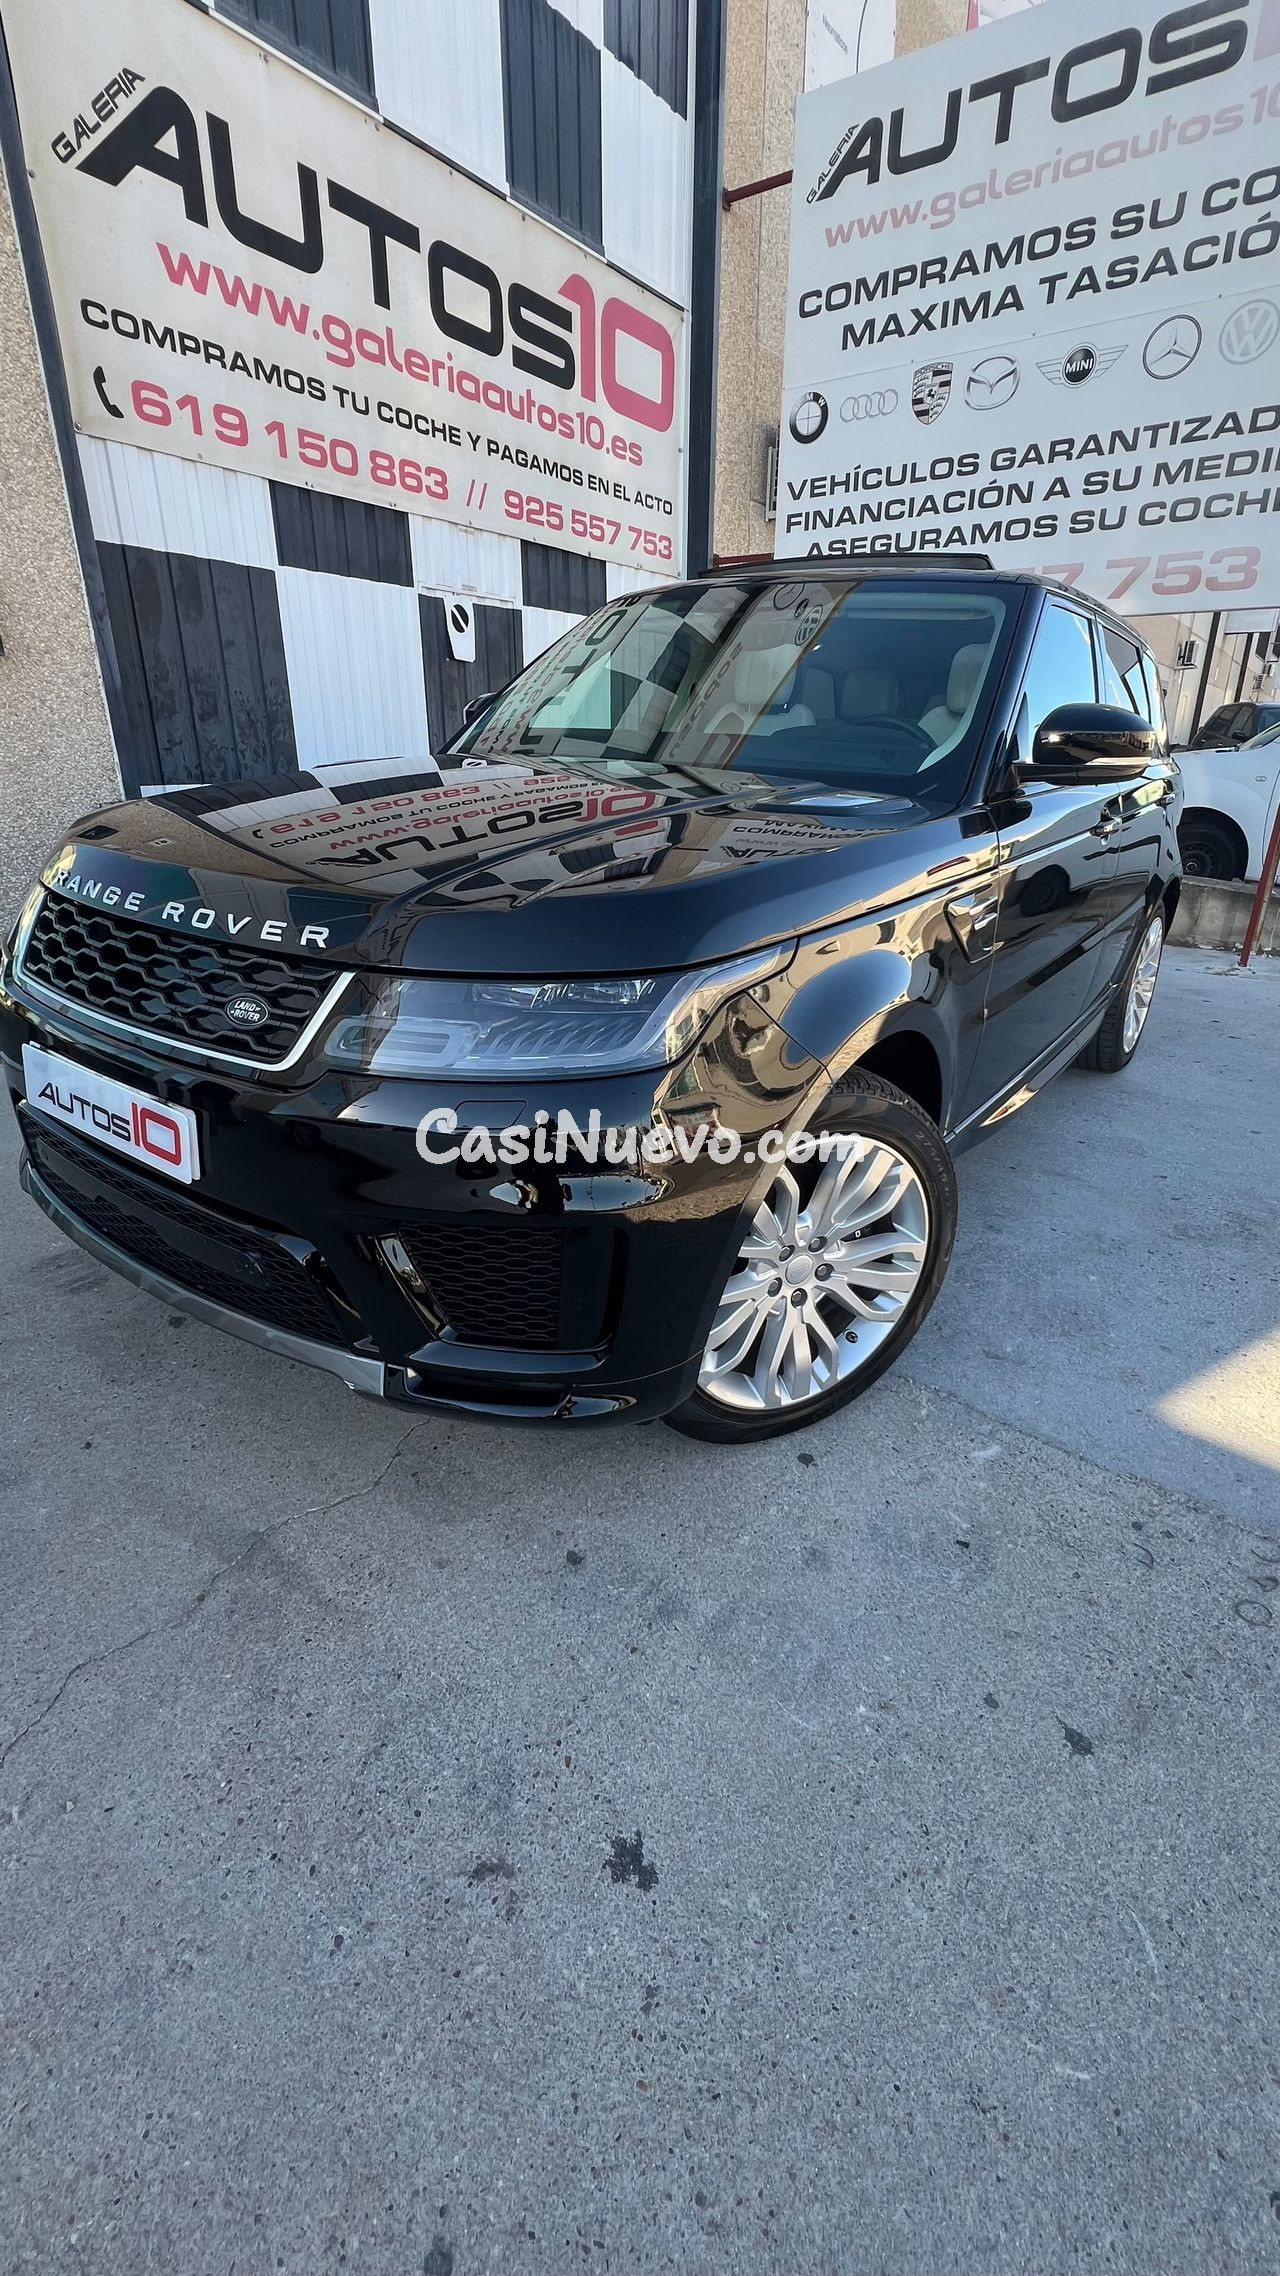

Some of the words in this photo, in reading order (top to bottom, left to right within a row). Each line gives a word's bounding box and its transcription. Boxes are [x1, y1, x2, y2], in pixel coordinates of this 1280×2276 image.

[51, 67, 146, 163] GALERIA
[75, 86, 674, 432] AUTOS10
[799, 217, 1096, 319] COMPRAMOS
[1110, 190, 1187, 240] SU
[1201, 166, 1280, 217] CO
[841, 285, 1026, 351] MAXIMA
[1039, 211, 1280, 305] TASACIÓ
[156, 242, 643, 467] www.galeriaautos10.es
[1066, 357, 1094, 374] MINI
[80, 299, 326, 401] COMPRAMOS
[333, 385, 369, 414] TU
[377, 403, 461, 446] COCHE
[467, 431, 481, 451] Y
[487, 438, 583, 487] PAGAMOS
[588, 473, 609, 495] EN
[613, 484, 630, 502] EL
[634, 491, 673, 516] ACTO
[787, 452, 980, 501] VEHÍCULOS
[990, 405, 1280, 473] GARANTIZAD
[131, 380, 249, 447] 619
[264, 421, 359, 476] 150
[369, 456, 449, 501] 863
[504, 489, 564, 532] 925
[571, 508, 621, 545] 557
[628, 525, 673, 560] 753
[786, 480, 1036, 534] FINANCIACIÓN
[1043, 476, 1070, 501] A
[1083, 463, 1142, 495] SU
[805, 514, 1058, 558] ASEGURAMOS
[1069, 505, 1127, 533] SU
[1106, 546, 1262, 600] 753
[54, 867, 146, 913] RANGE
[162, 901, 329, 949] ROVER
